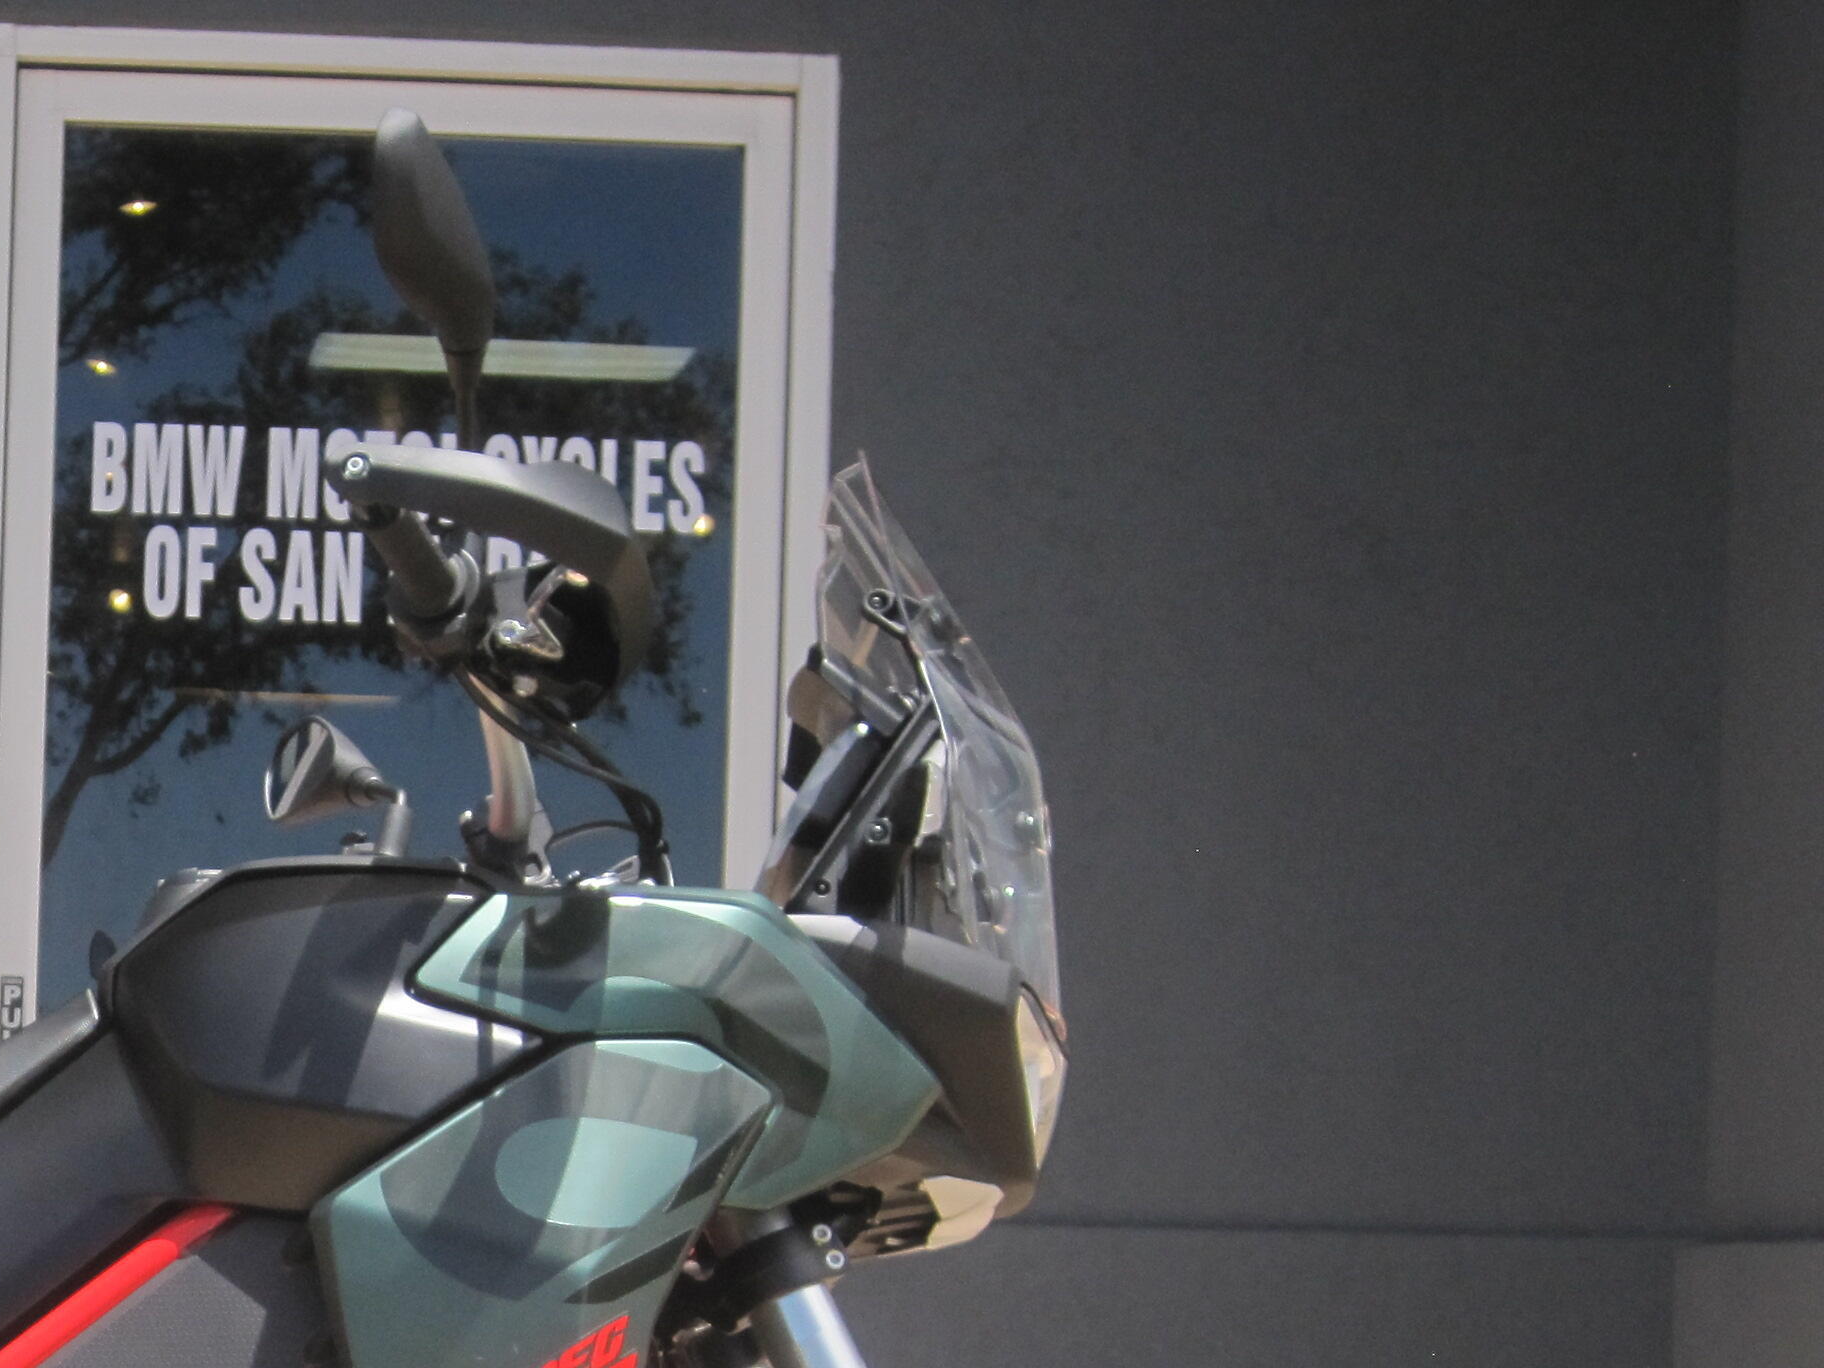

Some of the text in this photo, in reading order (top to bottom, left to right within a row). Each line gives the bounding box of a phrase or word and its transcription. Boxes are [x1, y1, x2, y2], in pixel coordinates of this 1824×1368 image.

[89, 420, 247, 518] BMW
[142, 524, 217, 620] OF
[237, 524, 365, 625] SAN
[1, 983, 23, 1041] PU
